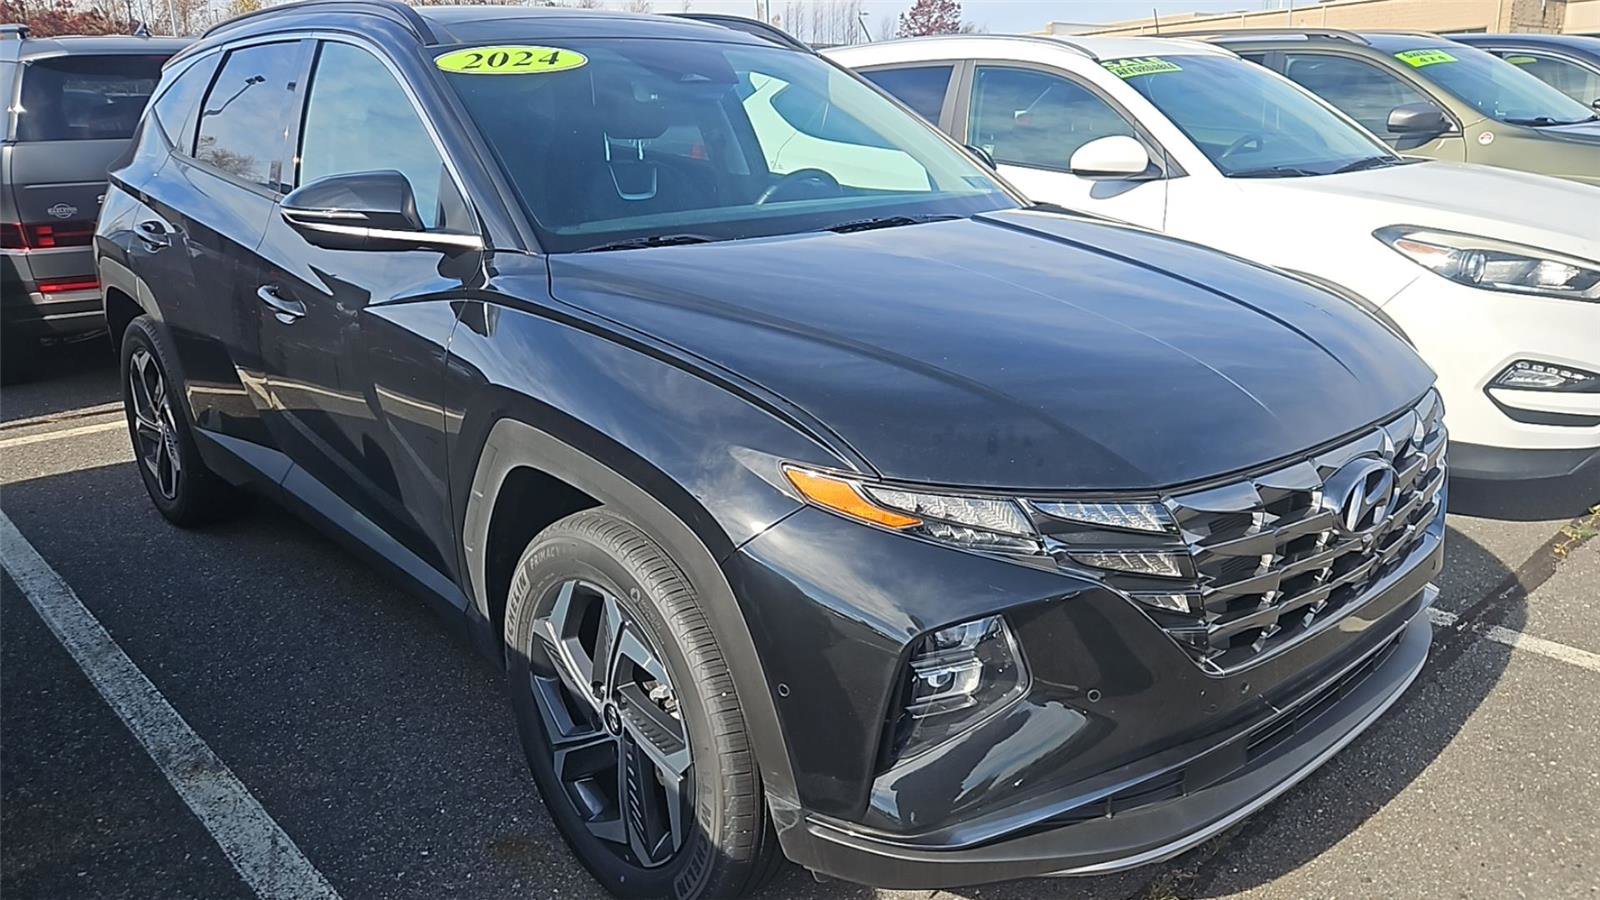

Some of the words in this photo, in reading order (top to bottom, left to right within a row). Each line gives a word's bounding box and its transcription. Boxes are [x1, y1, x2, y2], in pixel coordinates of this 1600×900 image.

[461, 50, 561, 70] 2024
[530, 545, 561, 570] PRIMACY
[506, 571, 527, 645] ICHELIN
